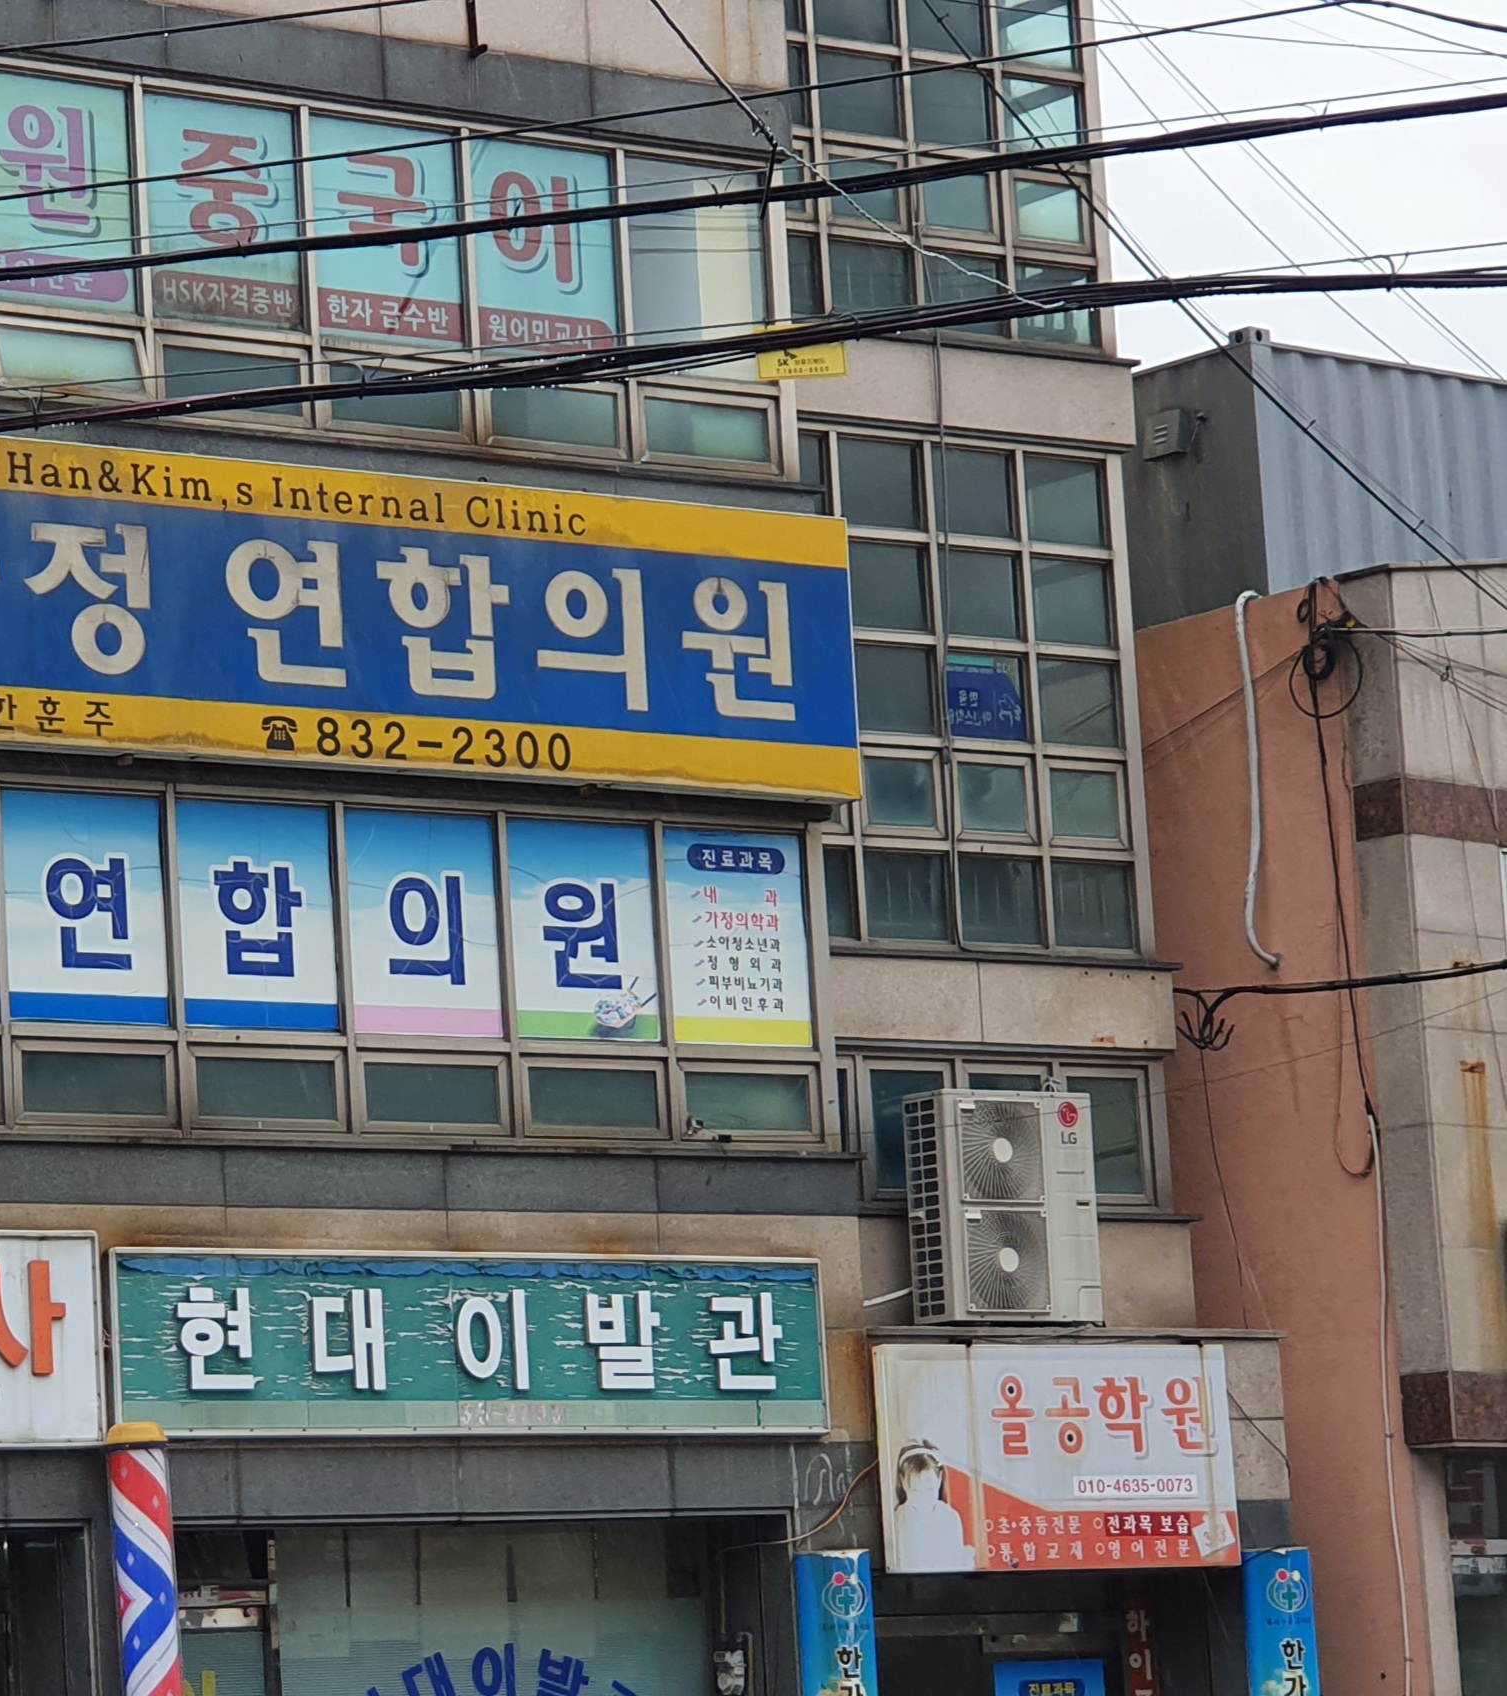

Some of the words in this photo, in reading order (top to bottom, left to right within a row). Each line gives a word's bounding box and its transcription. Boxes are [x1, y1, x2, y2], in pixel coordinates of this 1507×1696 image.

[162, 277, 293, 317] HSK자격증반
[326, 293, 373, 327] 한자
[380, 301, 449, 335] 급수반
[488, 314, 593, 349] 원어민교사
[271, 476, 446, 524] Internal
[466, 496, 588, 537] Clinic
[225, 539, 796, 722] 연합의원
[316, 716, 572, 772] 832-2300
[701, 848, 773, 872] 진료과목
[705, 911, 780, 931] 가정의학과
[706, 935, 781, 953] 소아청소년과
[709, 976, 783, 993] 피부비뇨기과
[710, 996, 784, 1013] 이비인후과
[1060, 1131, 1078, 1145] LG
[176, 1287, 783, 1391] 현대이발관
[991, 1374, 1212, 1455] 올공학원
[1077, 1477, 1193, 1495] 010-4635-0073
[1106, 1514, 1152, 1534] 전과목
[1160, 1515, 1190, 1534] 보습
